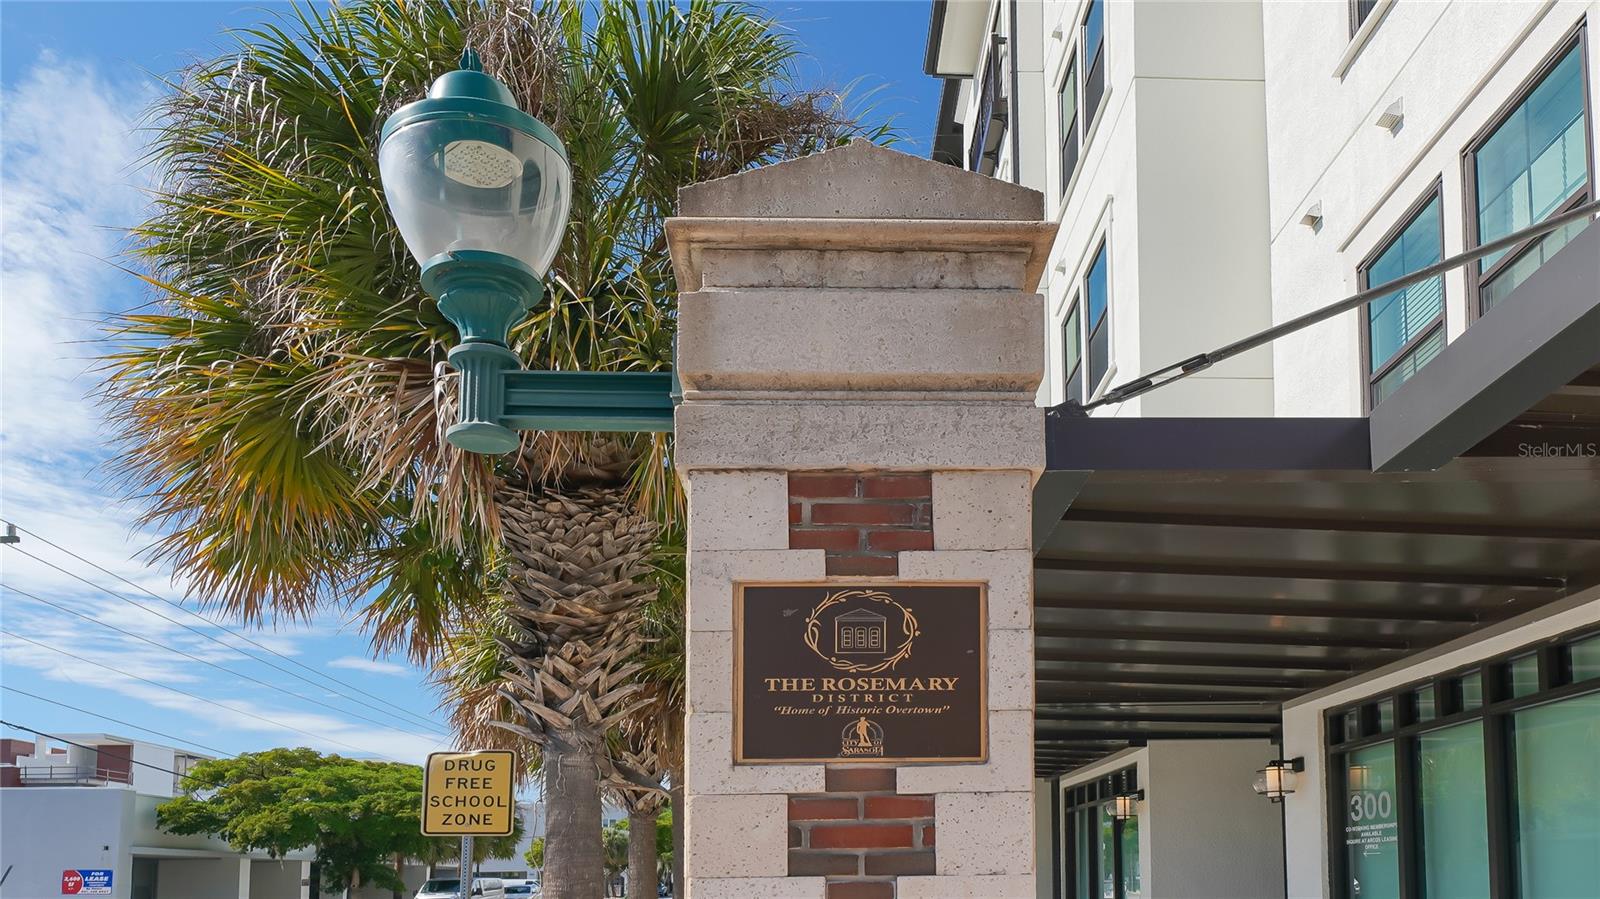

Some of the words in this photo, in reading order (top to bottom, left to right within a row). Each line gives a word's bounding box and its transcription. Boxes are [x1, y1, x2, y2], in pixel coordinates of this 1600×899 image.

[764, 677, 816, 692] THE
[821, 677, 960, 692] ROSEMARY
[812, 693, 914, 703] DISTRICT
[818, 705, 832, 717] of
[836, 705, 883, 715] Historic
[444, 759, 496, 772] DRUG
[445, 777, 493, 790] FREE
[430, 795, 507, 808] SCHOOL
[1350, 791, 1391, 821] 300
[441, 813, 493, 826] ZONE
